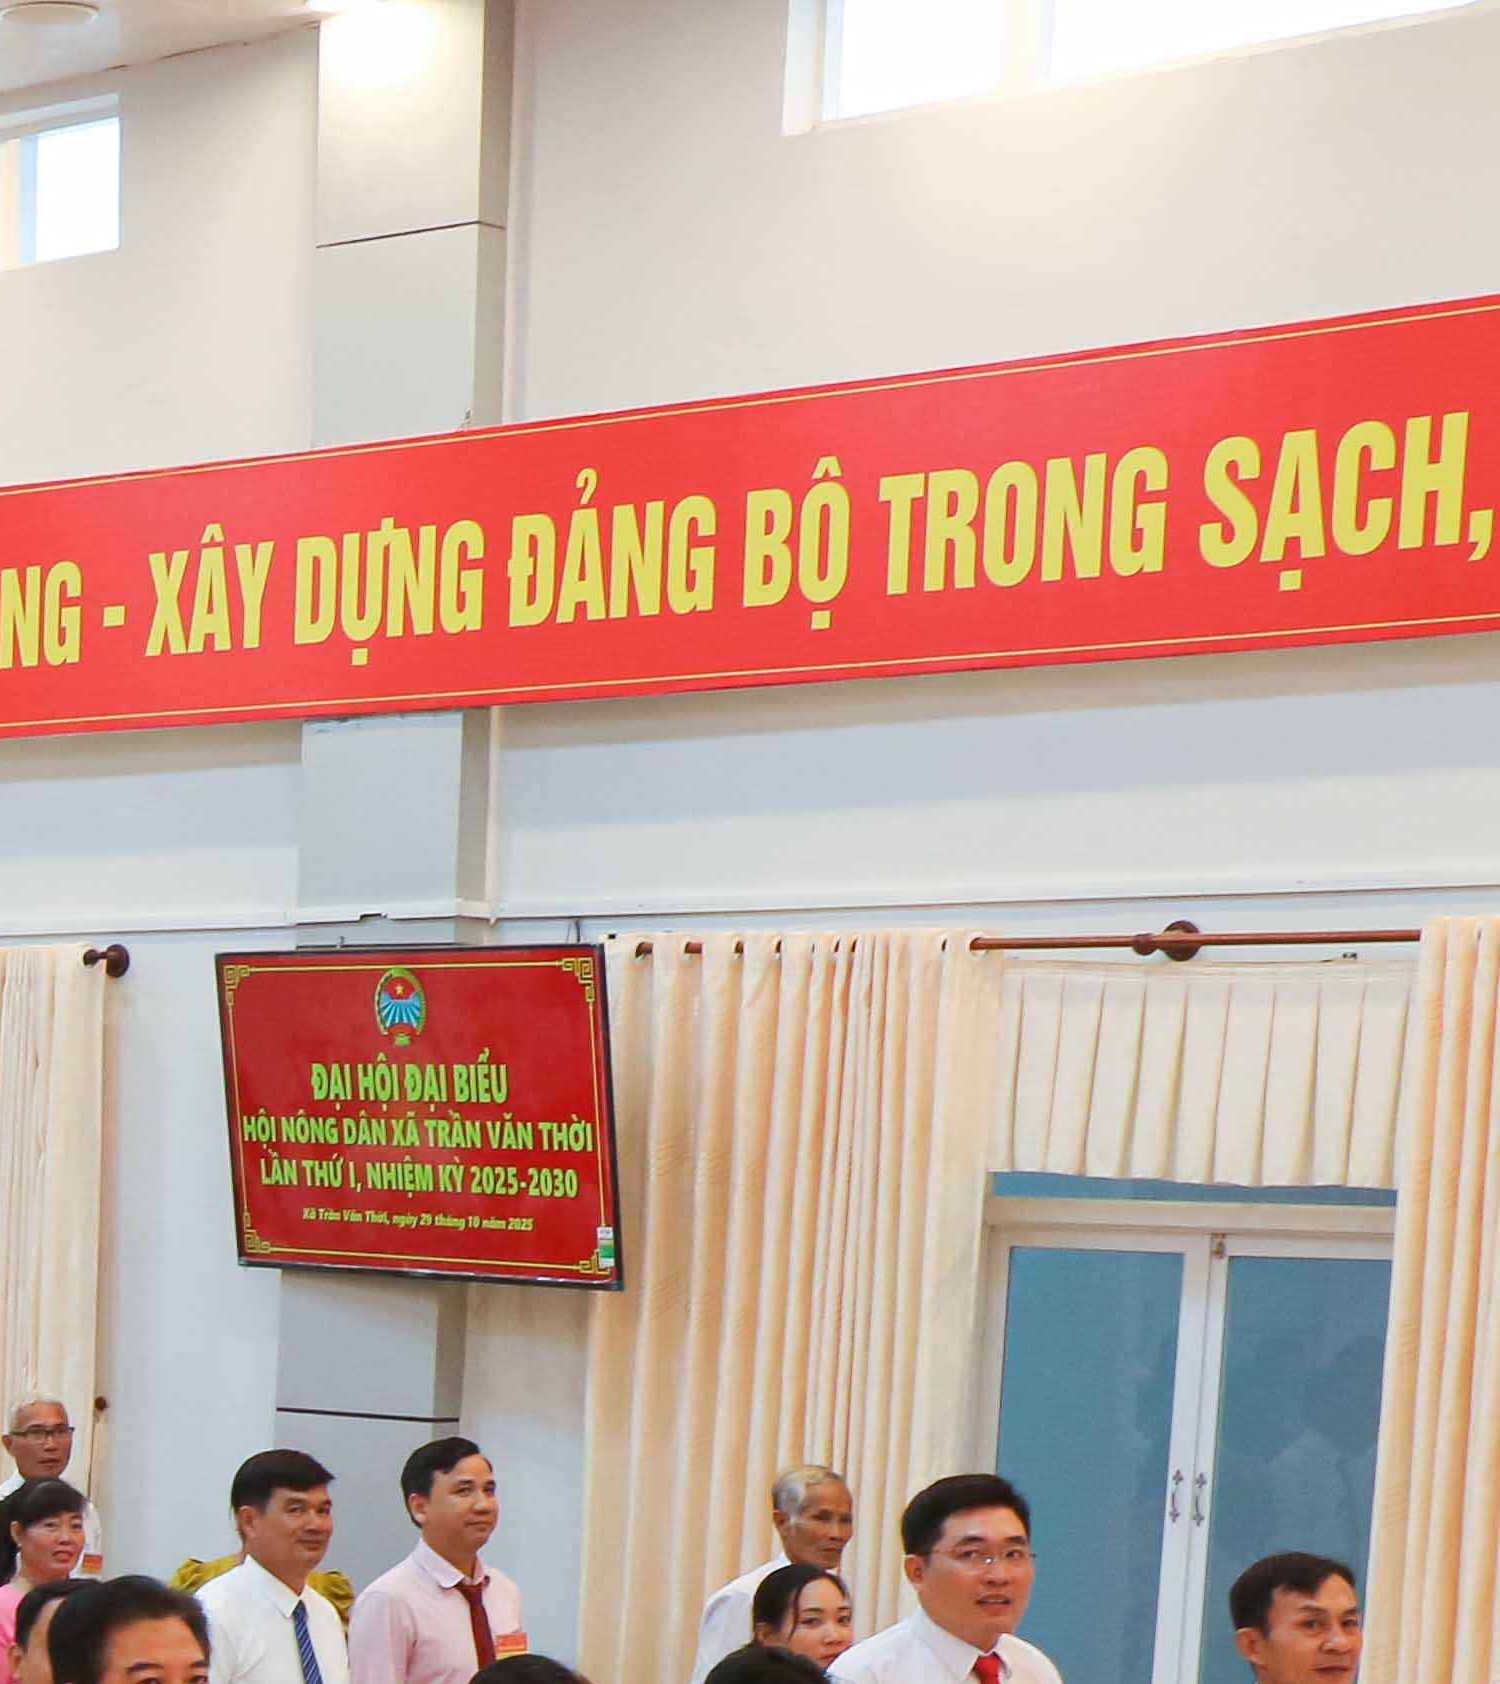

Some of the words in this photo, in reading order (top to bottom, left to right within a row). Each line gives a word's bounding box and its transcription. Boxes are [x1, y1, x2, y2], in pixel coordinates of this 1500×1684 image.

[103, 605, 125, 627] -
[146, 523, 275, 656] XÂY
[294, 517, 484, 666] DỰNG
[507, 468, 716, 627] ĐẢNG
[743, 456, 850, 629] BỘ
[879, 446, 1168, 595] TRONG
[1199, 412, 1494, 591] SẠCH,
[311, 1063, 352, 1110] ĐẠI
[358, 1053, 399, 1111] HỘI
[404, 1063, 447, 1112] ĐẠI
[453, 1046, 509, 1104] BIỂU
[243, 1108, 277, 1149] HỘI
[281, 1109, 339, 1145] NÔNG
[343, 1111, 387, 1147] DÂN
[391, 1111, 420, 1147] XÃ
[424, 1110, 482, 1150] TRẦN
[485, 1112, 534, 1151] VĂN
[537, 1114, 594, 1152] THỜI
[260, 1149, 298, 1187] LẦN
[302, 1153, 344, 1188] THỨ
[349, 1161, 363, 1194] I,
[366, 1156, 434, 1199] NHIỆM
[438, 1156, 464, 1193] KỲ
[469, 1165, 579, 1198] 2025-2030
[467, 1215, 480, 1229] 10
[508, 1217, 534, 1231] 2025
